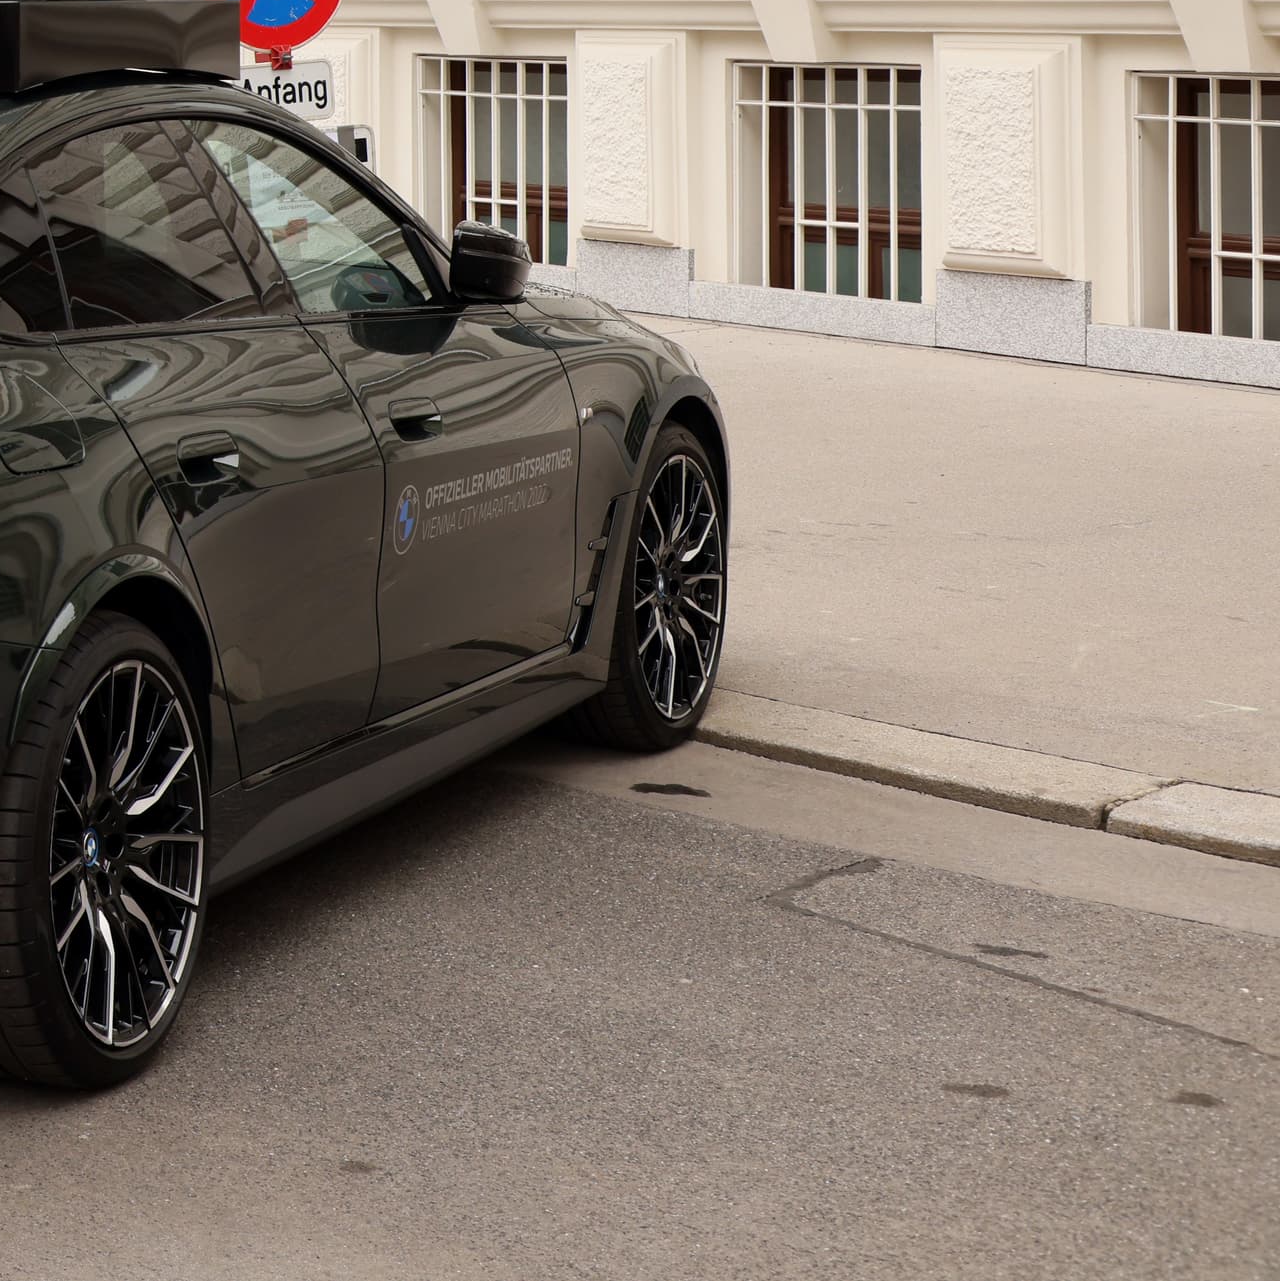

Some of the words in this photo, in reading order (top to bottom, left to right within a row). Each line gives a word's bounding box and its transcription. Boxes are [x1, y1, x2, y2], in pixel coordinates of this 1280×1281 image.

[424, 472, 485, 510] OFFIZIELLER
[484, 446, 574, 493] MOBILITÄTSPARTNER.
[420, 513, 456, 541] VIENNA
[457, 504, 479, 531] CITY
[478, 489, 527, 522] MARATHON
